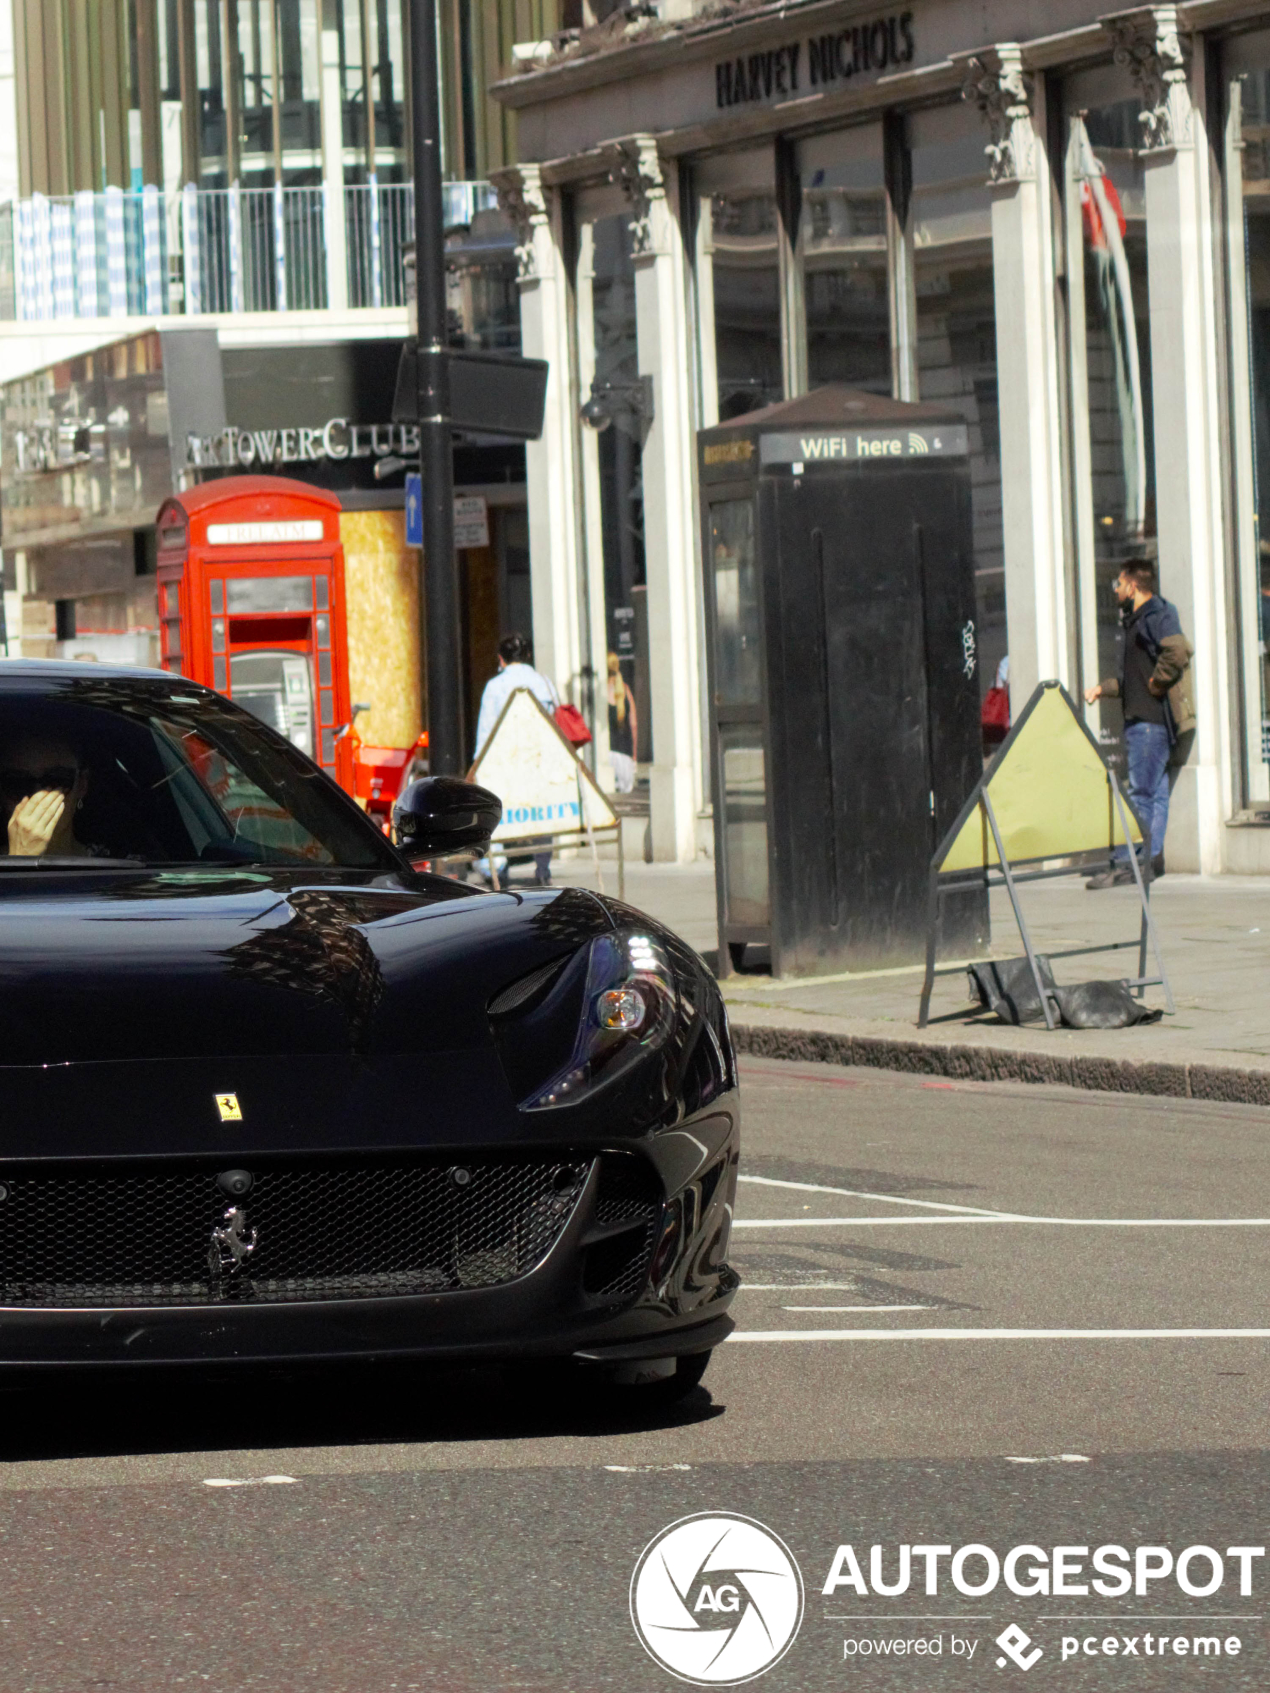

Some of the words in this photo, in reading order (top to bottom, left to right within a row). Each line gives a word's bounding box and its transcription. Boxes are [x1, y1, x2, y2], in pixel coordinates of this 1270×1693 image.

[716, 42, 800, 109] HARVEY
[808, 11, 915, 86] NICHOLS
[222, 427, 316, 466] TOWER
[322, 417, 421, 460] CLUB
[800, 437, 847, 459] WiFi
[856, 435, 902, 457] here
